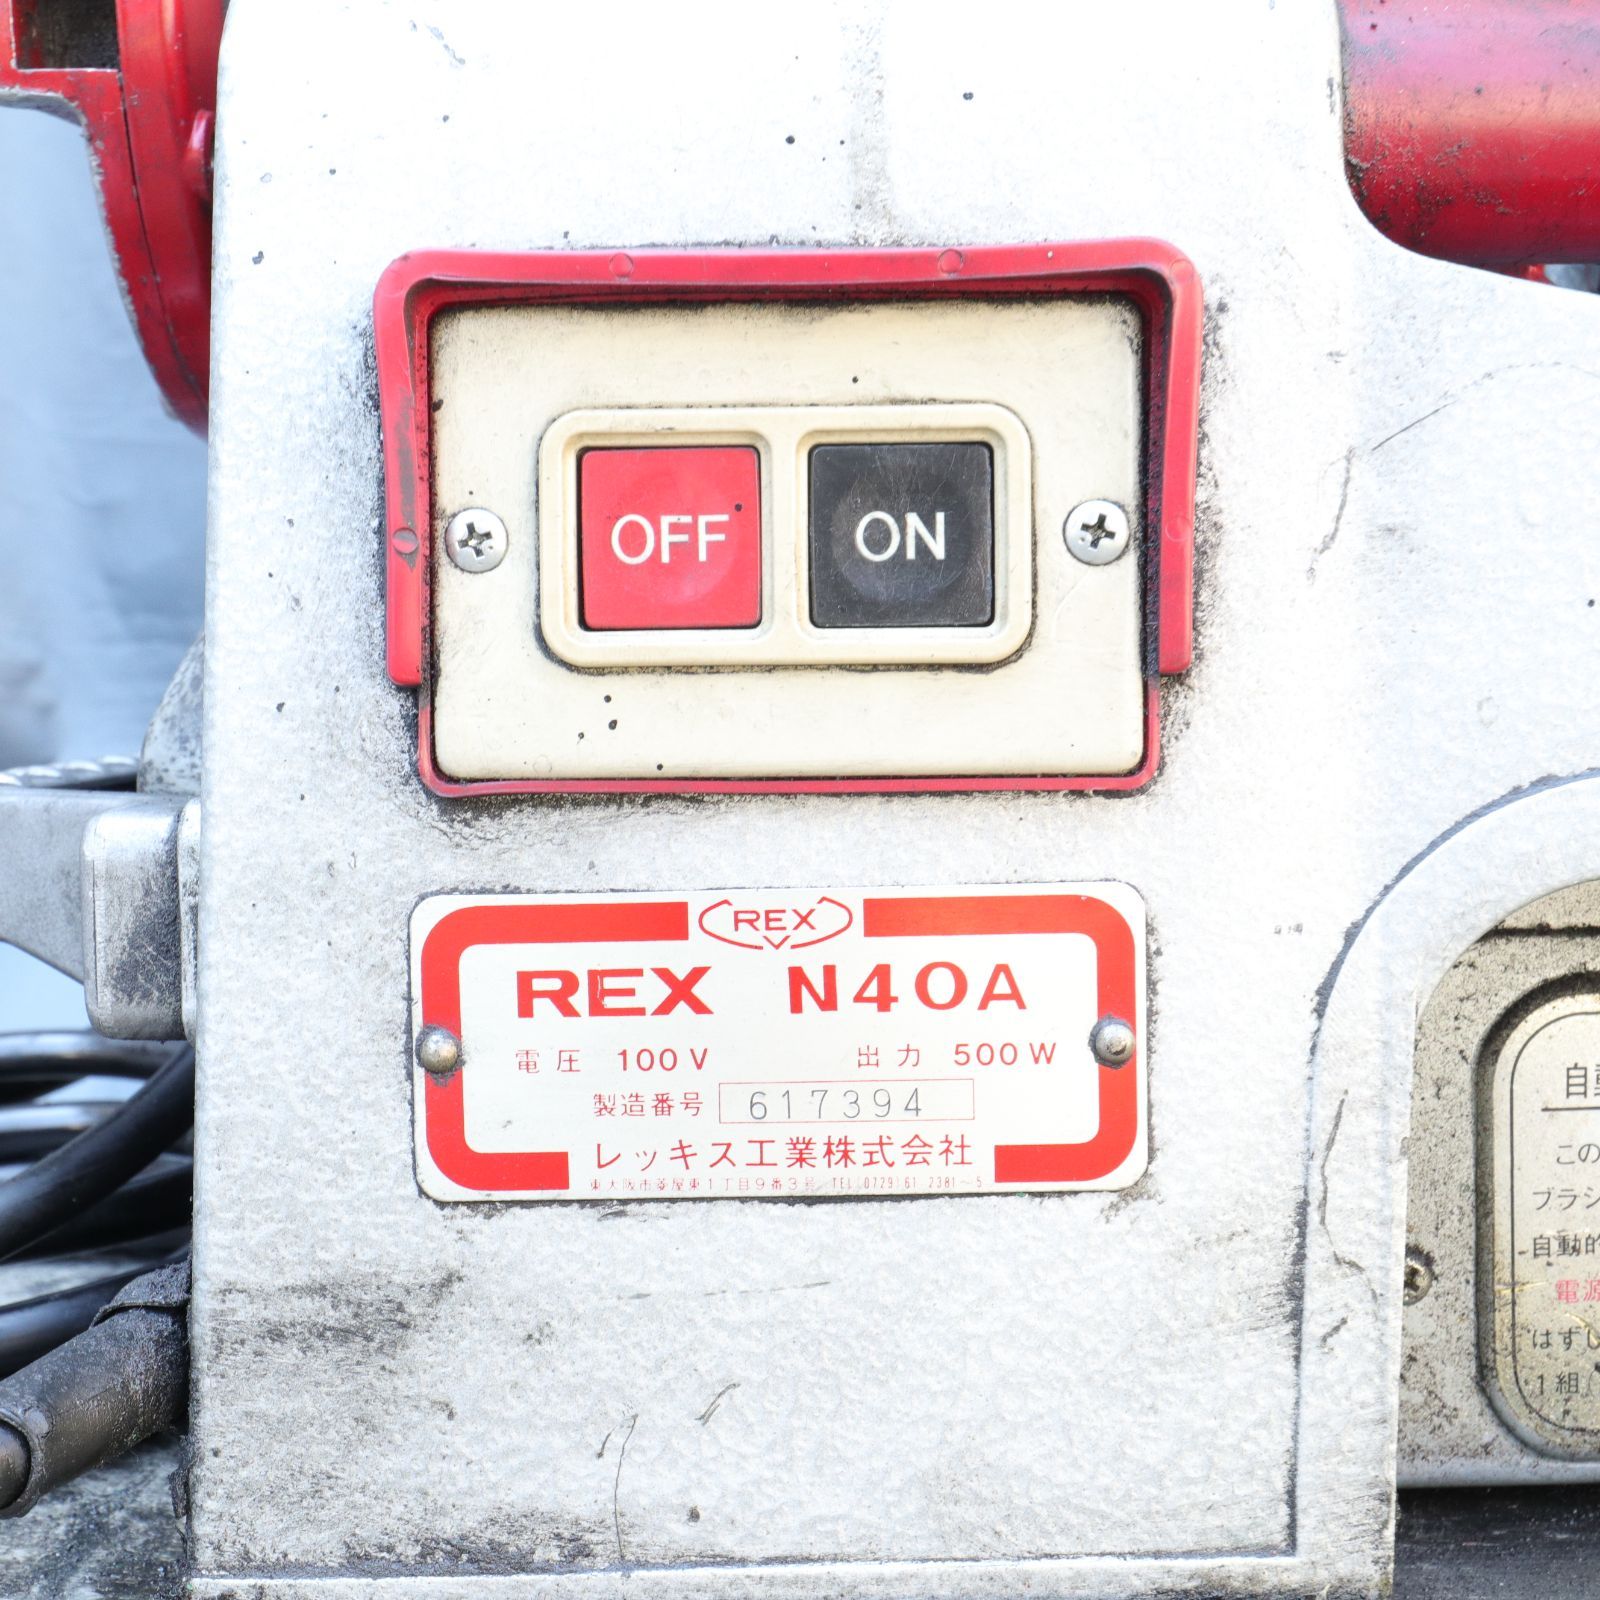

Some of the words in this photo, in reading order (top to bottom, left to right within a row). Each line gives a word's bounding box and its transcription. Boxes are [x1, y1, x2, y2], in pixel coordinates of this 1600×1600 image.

[610, 513, 730, 566] OFF
[854, 510, 946, 563] ON
[733, 907, 817, 932] REX
[516, 965, 714, 1018] REX
[787, 961, 1027, 1014] N40A
[593, 1092, 704, 1117] 製造番号
[749, 1087, 923, 1120] 617394
[596, 1134, 973, 1172] レッキス工業株式会社
